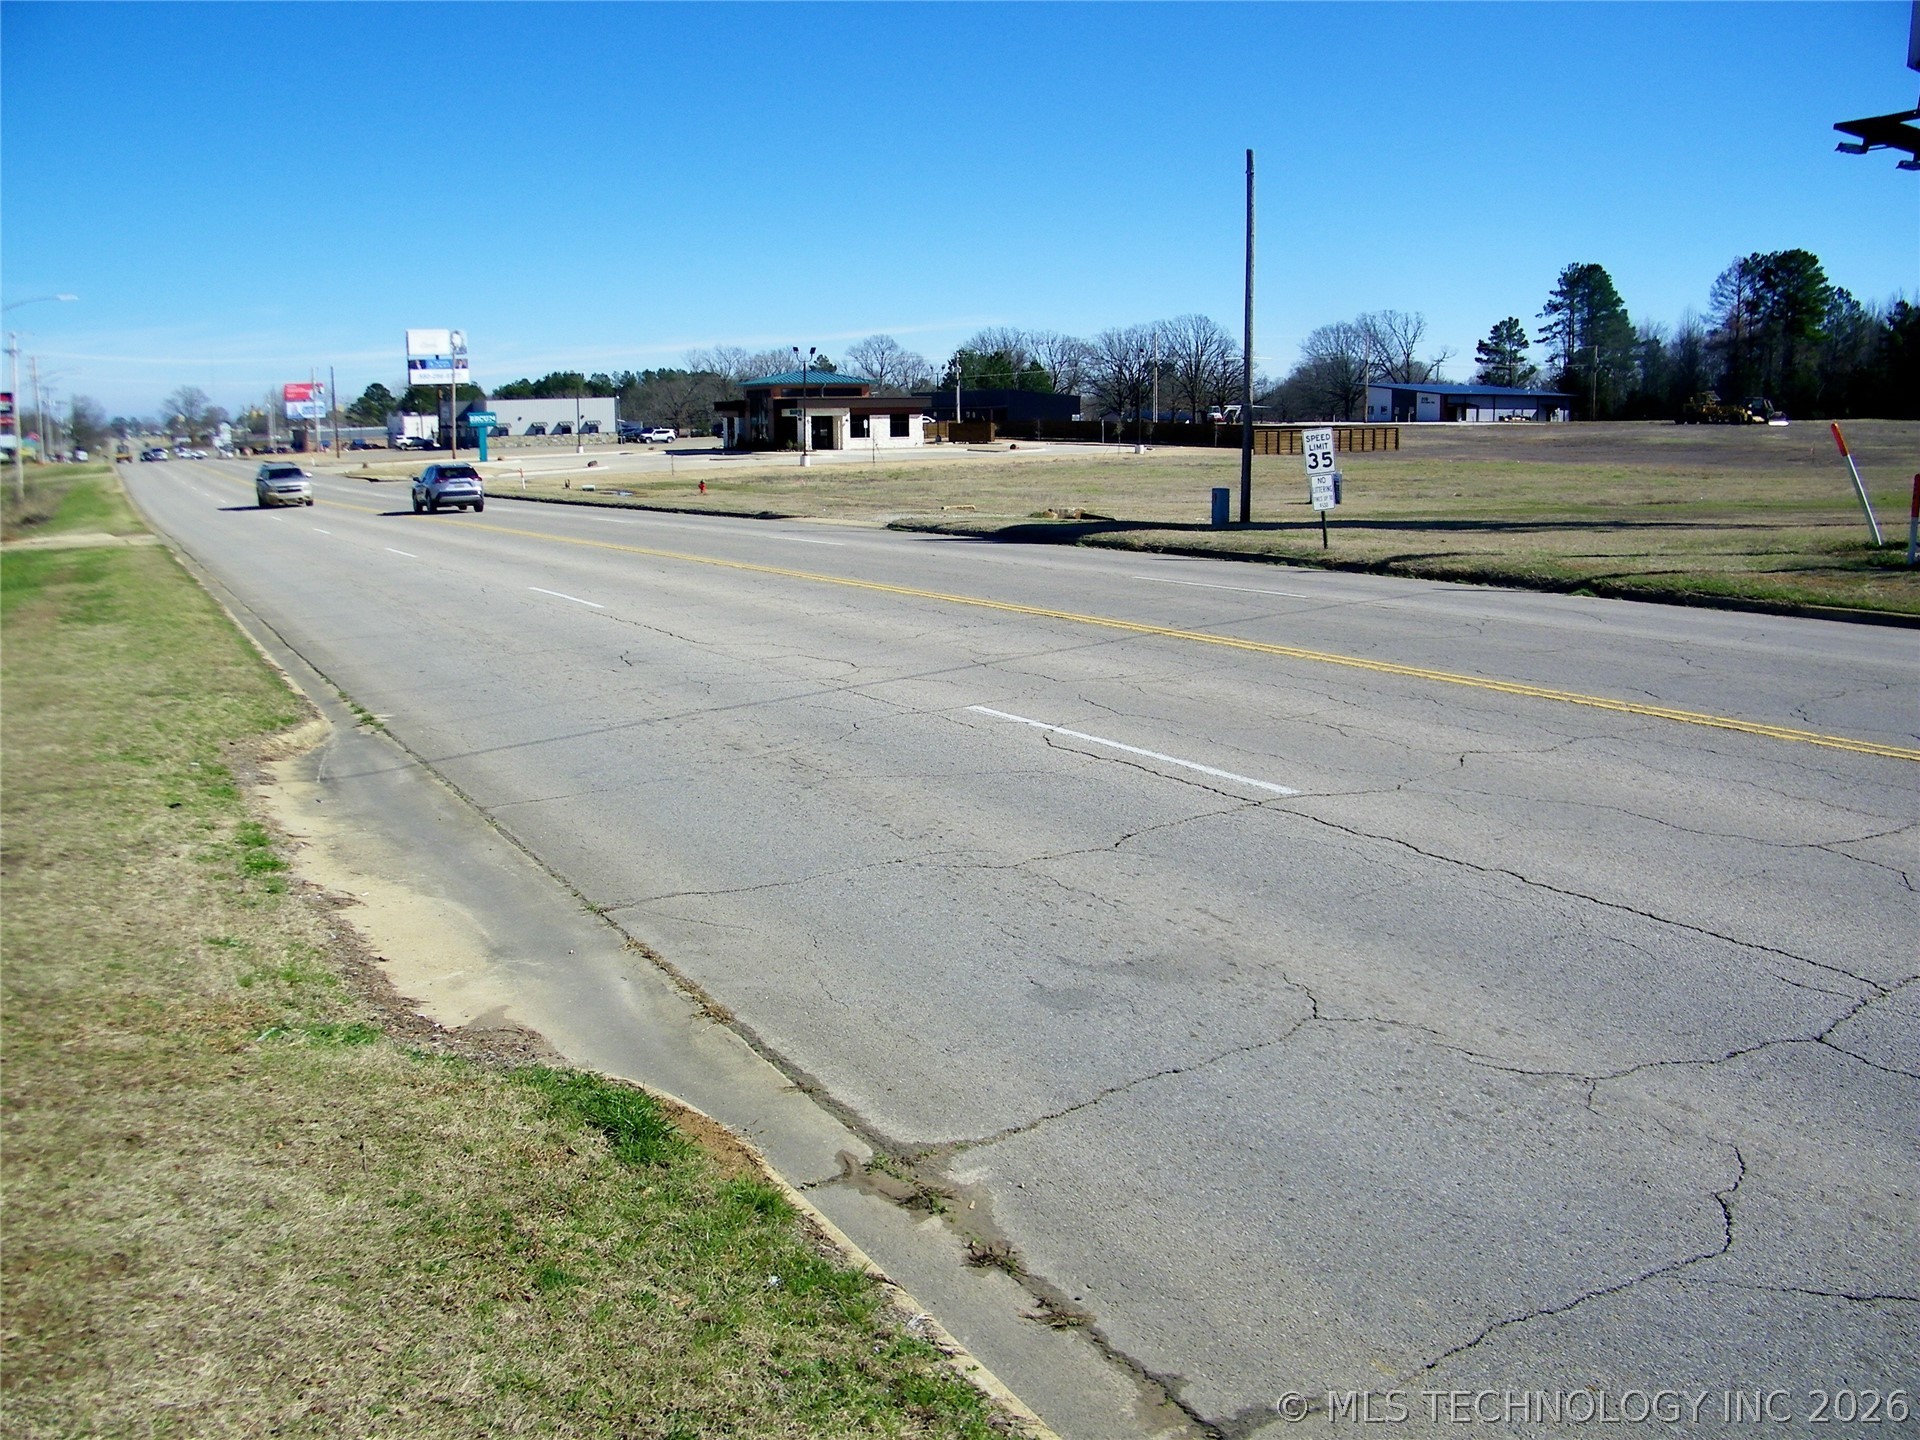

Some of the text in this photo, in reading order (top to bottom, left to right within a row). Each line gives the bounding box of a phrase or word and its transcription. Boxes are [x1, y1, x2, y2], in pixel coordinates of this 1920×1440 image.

[1305, 434, 1331, 443] SPEED
[1308, 442, 1328, 451] LIMIT
[1308, 451, 1333, 469] 35
